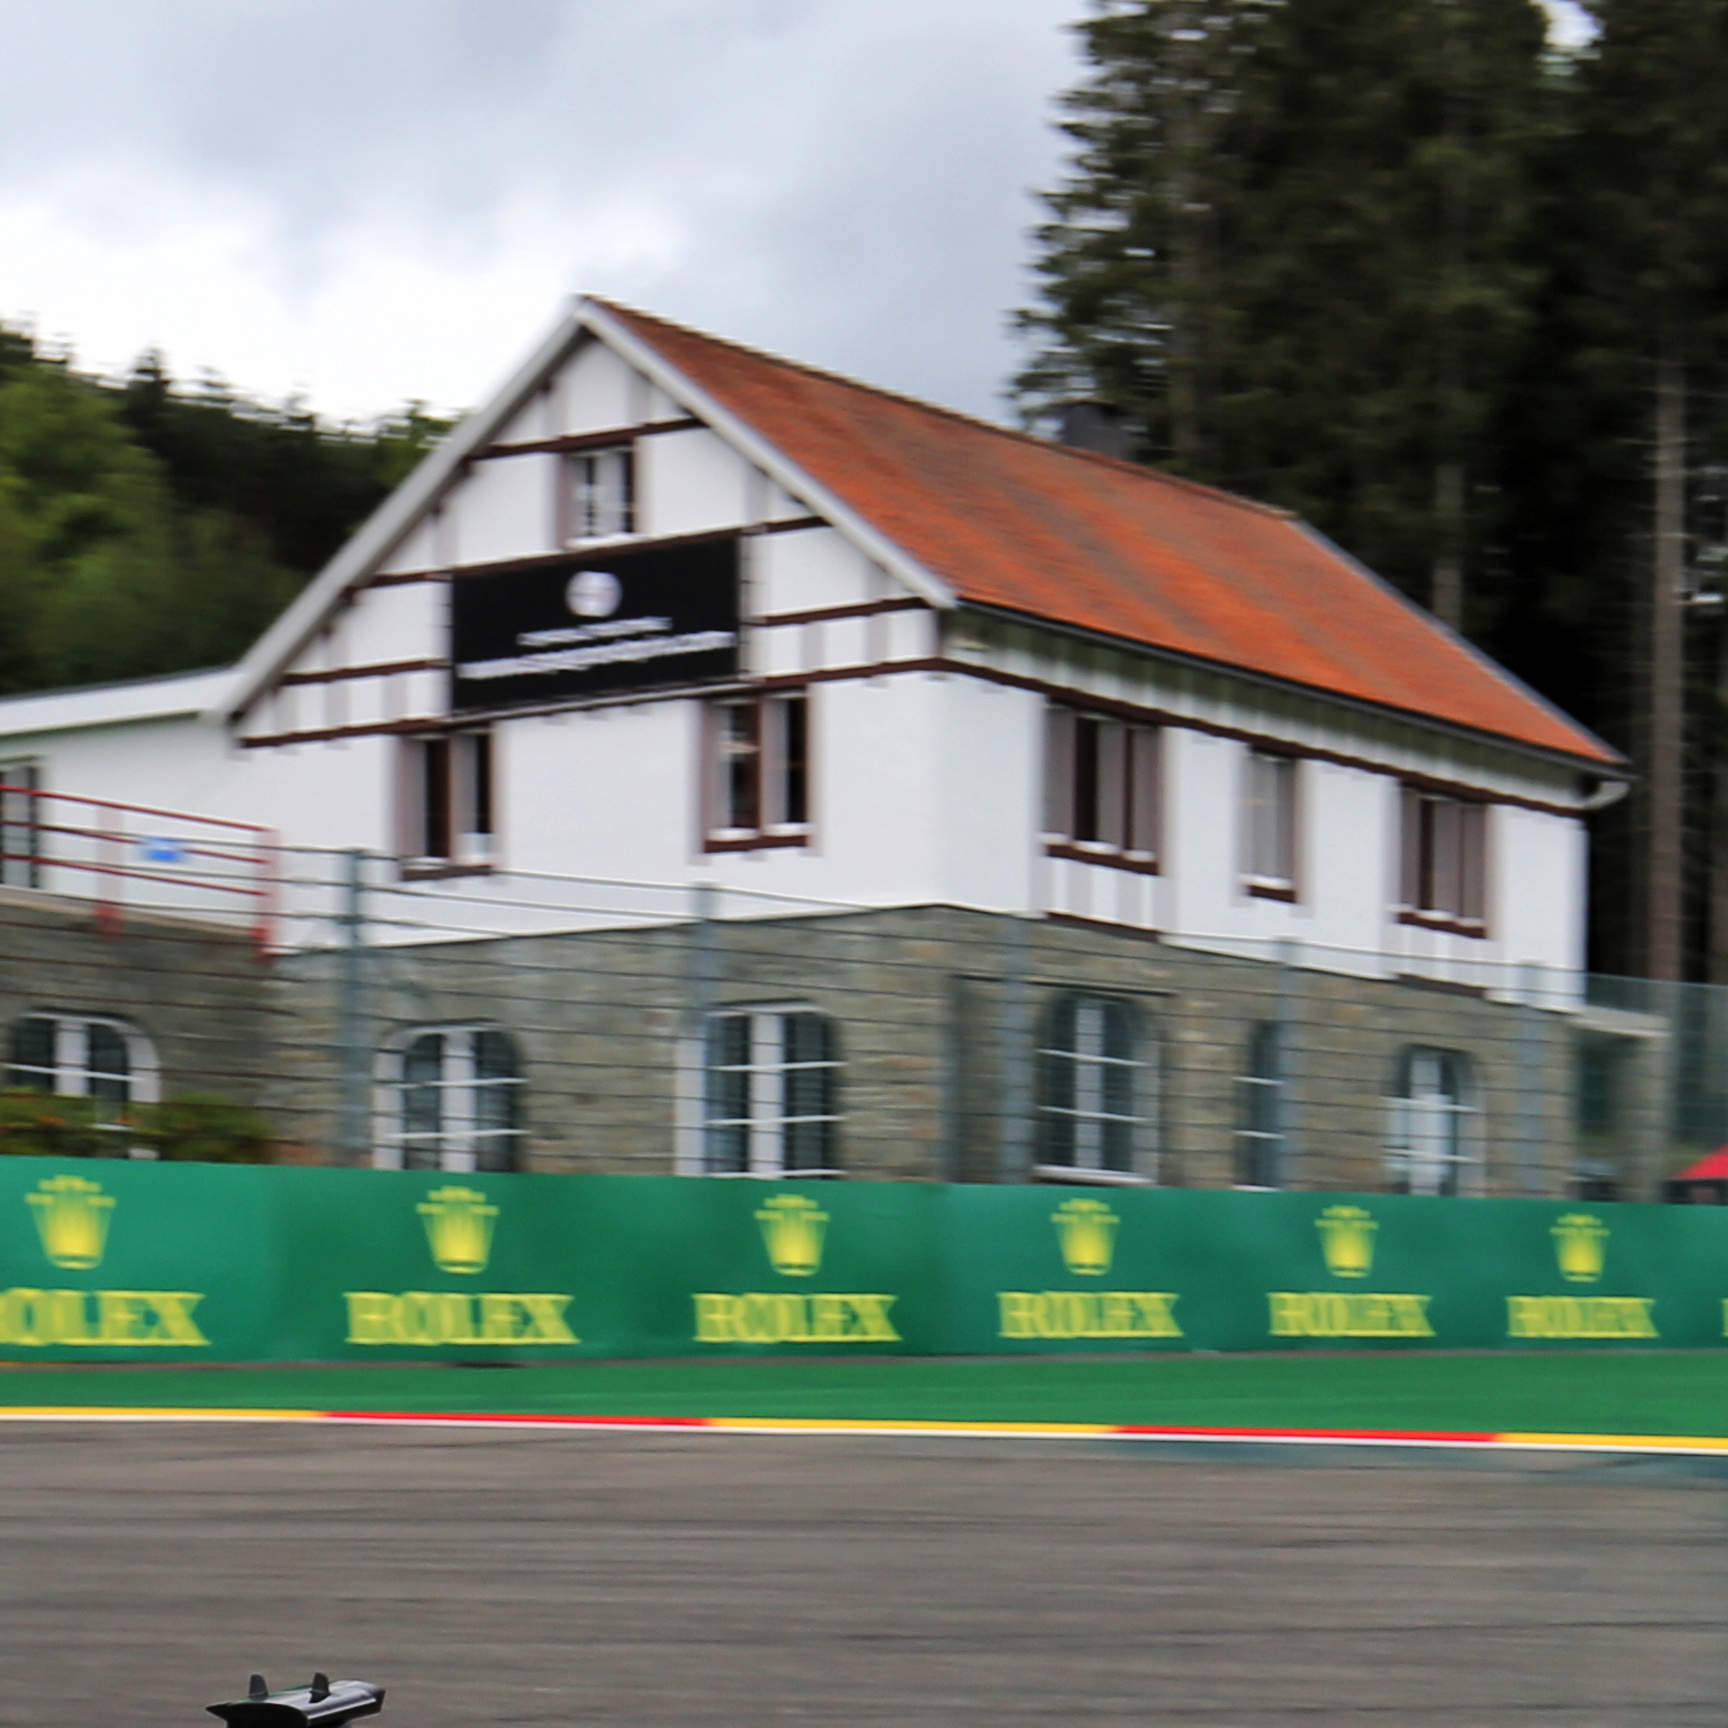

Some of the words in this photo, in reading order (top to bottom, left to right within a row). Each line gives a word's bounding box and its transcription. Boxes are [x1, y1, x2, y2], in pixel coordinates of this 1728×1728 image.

[343, 1290, 580, 1346] ROLEX
[692, 1292, 901, 1343] ROLEX
[997, 1291, 1184, 1338] ROLEX
